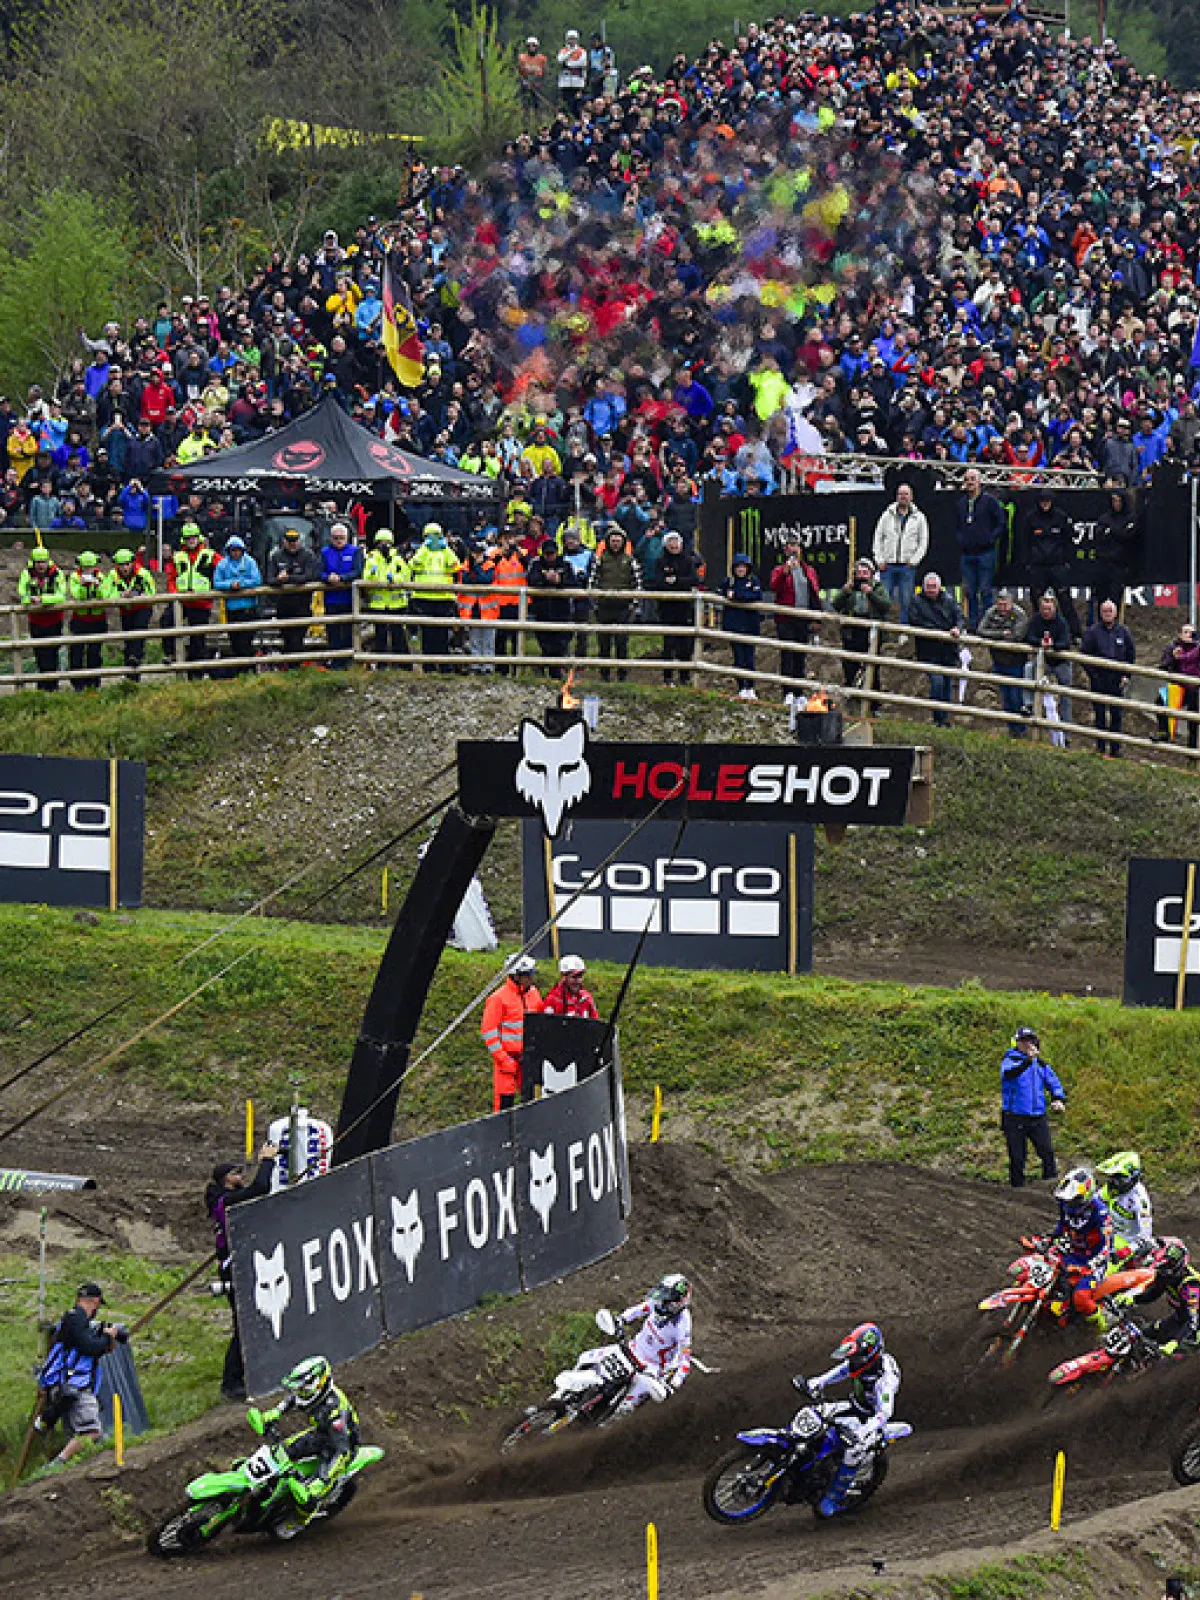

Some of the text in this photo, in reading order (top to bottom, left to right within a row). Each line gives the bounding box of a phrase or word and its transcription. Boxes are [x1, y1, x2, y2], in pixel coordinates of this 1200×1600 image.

[611, 761, 892, 806] HOLESHOT
[0, 792, 110, 830] Pro
[553, 853, 781, 895] GoPro
[435, 1165, 519, 1261] FOX
[302, 1214, 379, 1315] FOX
